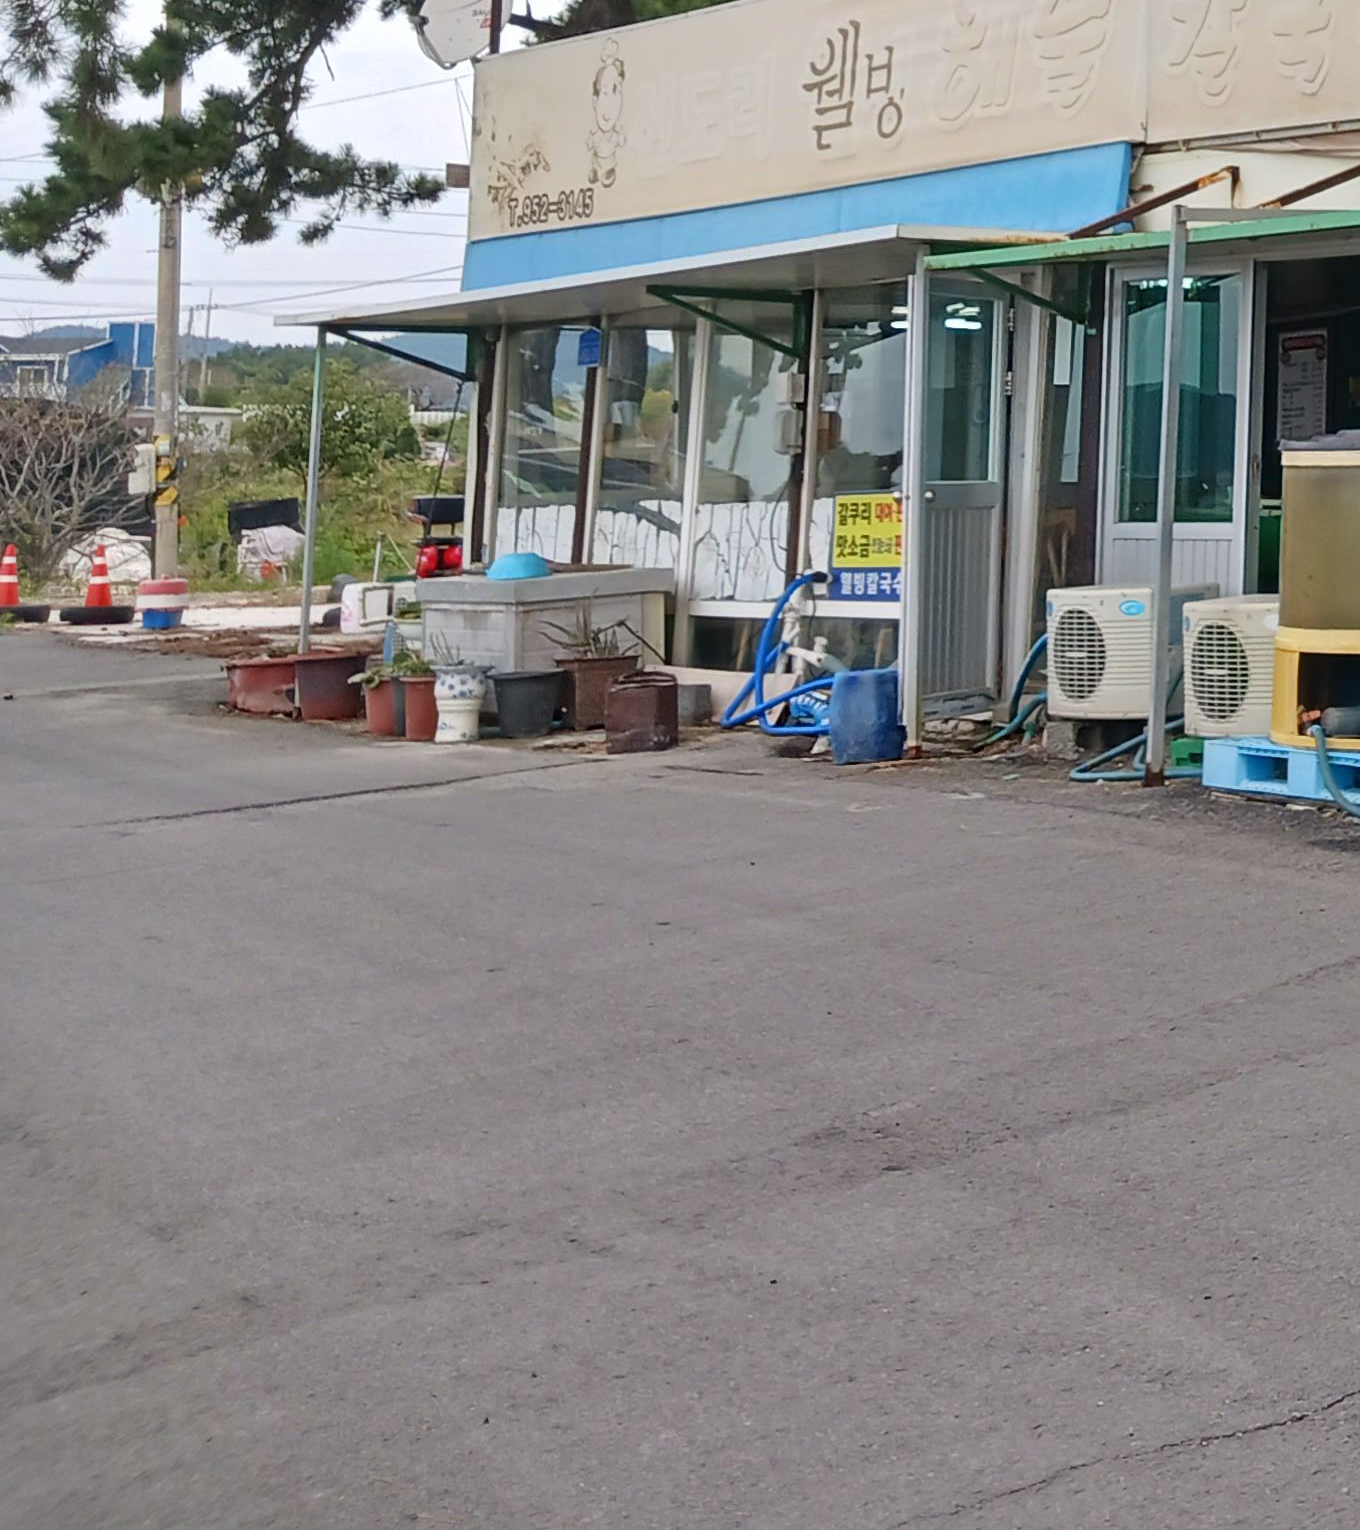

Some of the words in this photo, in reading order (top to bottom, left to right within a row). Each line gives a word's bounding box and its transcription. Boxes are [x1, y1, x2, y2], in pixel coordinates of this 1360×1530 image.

[803, 20, 903, 151] 웰빙
[508, 187, 595, 228] T.952-3145
[837, 502, 872, 527] 갈쿠리
[836, 534, 870, 559] 맛소금
